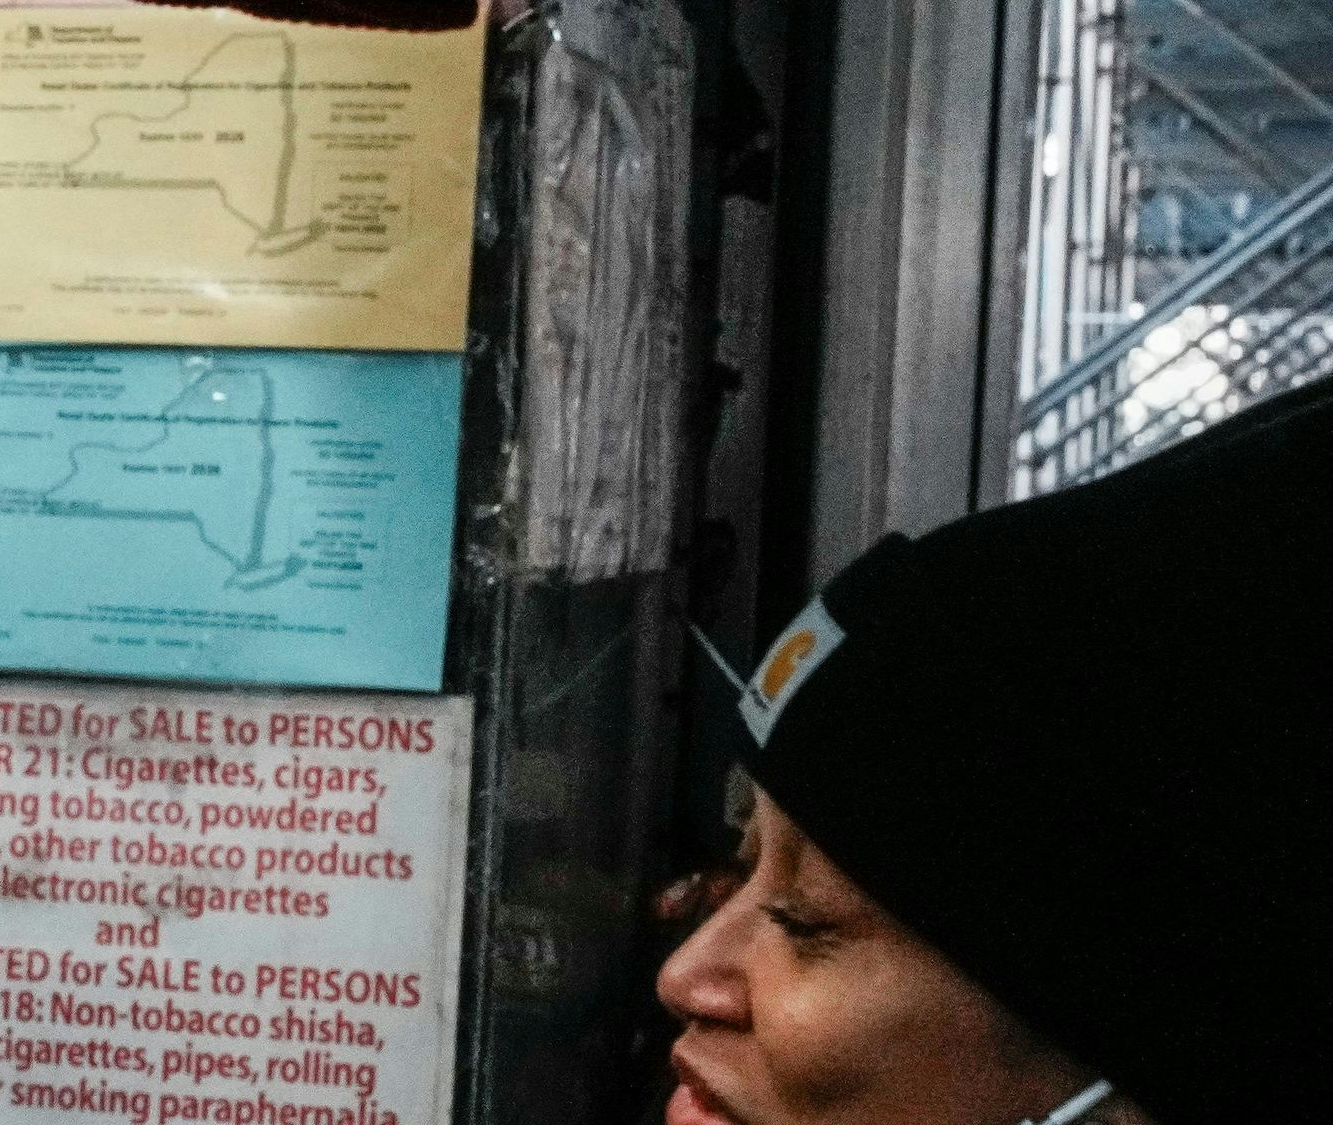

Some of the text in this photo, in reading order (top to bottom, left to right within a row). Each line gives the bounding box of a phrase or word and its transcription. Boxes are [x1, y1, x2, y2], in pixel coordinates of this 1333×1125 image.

[72, 702, 120, 740] for
[133, 706, 214, 744] SALE
[223, 718, 259, 746] to
[269, 712, 436, 754] PERSONS
[22, 745, 75, 779] 21:
[82, 746, 265, 792] Cigarettes,
[274, 756, 388, 799] cigars,
[49, 784, 191, 830] tobacco,
[199, 800, 379, 837] powdered
[9, 828, 103, 862] other
[111, 832, 245, 872] tobacco
[255, 843, 414, 881] products
[156, 874, 330, 919] cigarettes
[94, 915, 161, 949] and
[59, 950, 108, 987] for
[115, 955, 201, 993] SALE
[210, 963, 245, 996] to
[254, 963, 422, 1009] PERSONS
[0, 989, 44, 1024] 18:
[49, 992, 261, 1039] Non-tobacco
[270, 1006, 386, 1052] shisha,
[161, 1041, 259, 1085] pipes,
[265, 1049, 378, 1098] rolling
[10, 1075, 152, 1125] smoking
